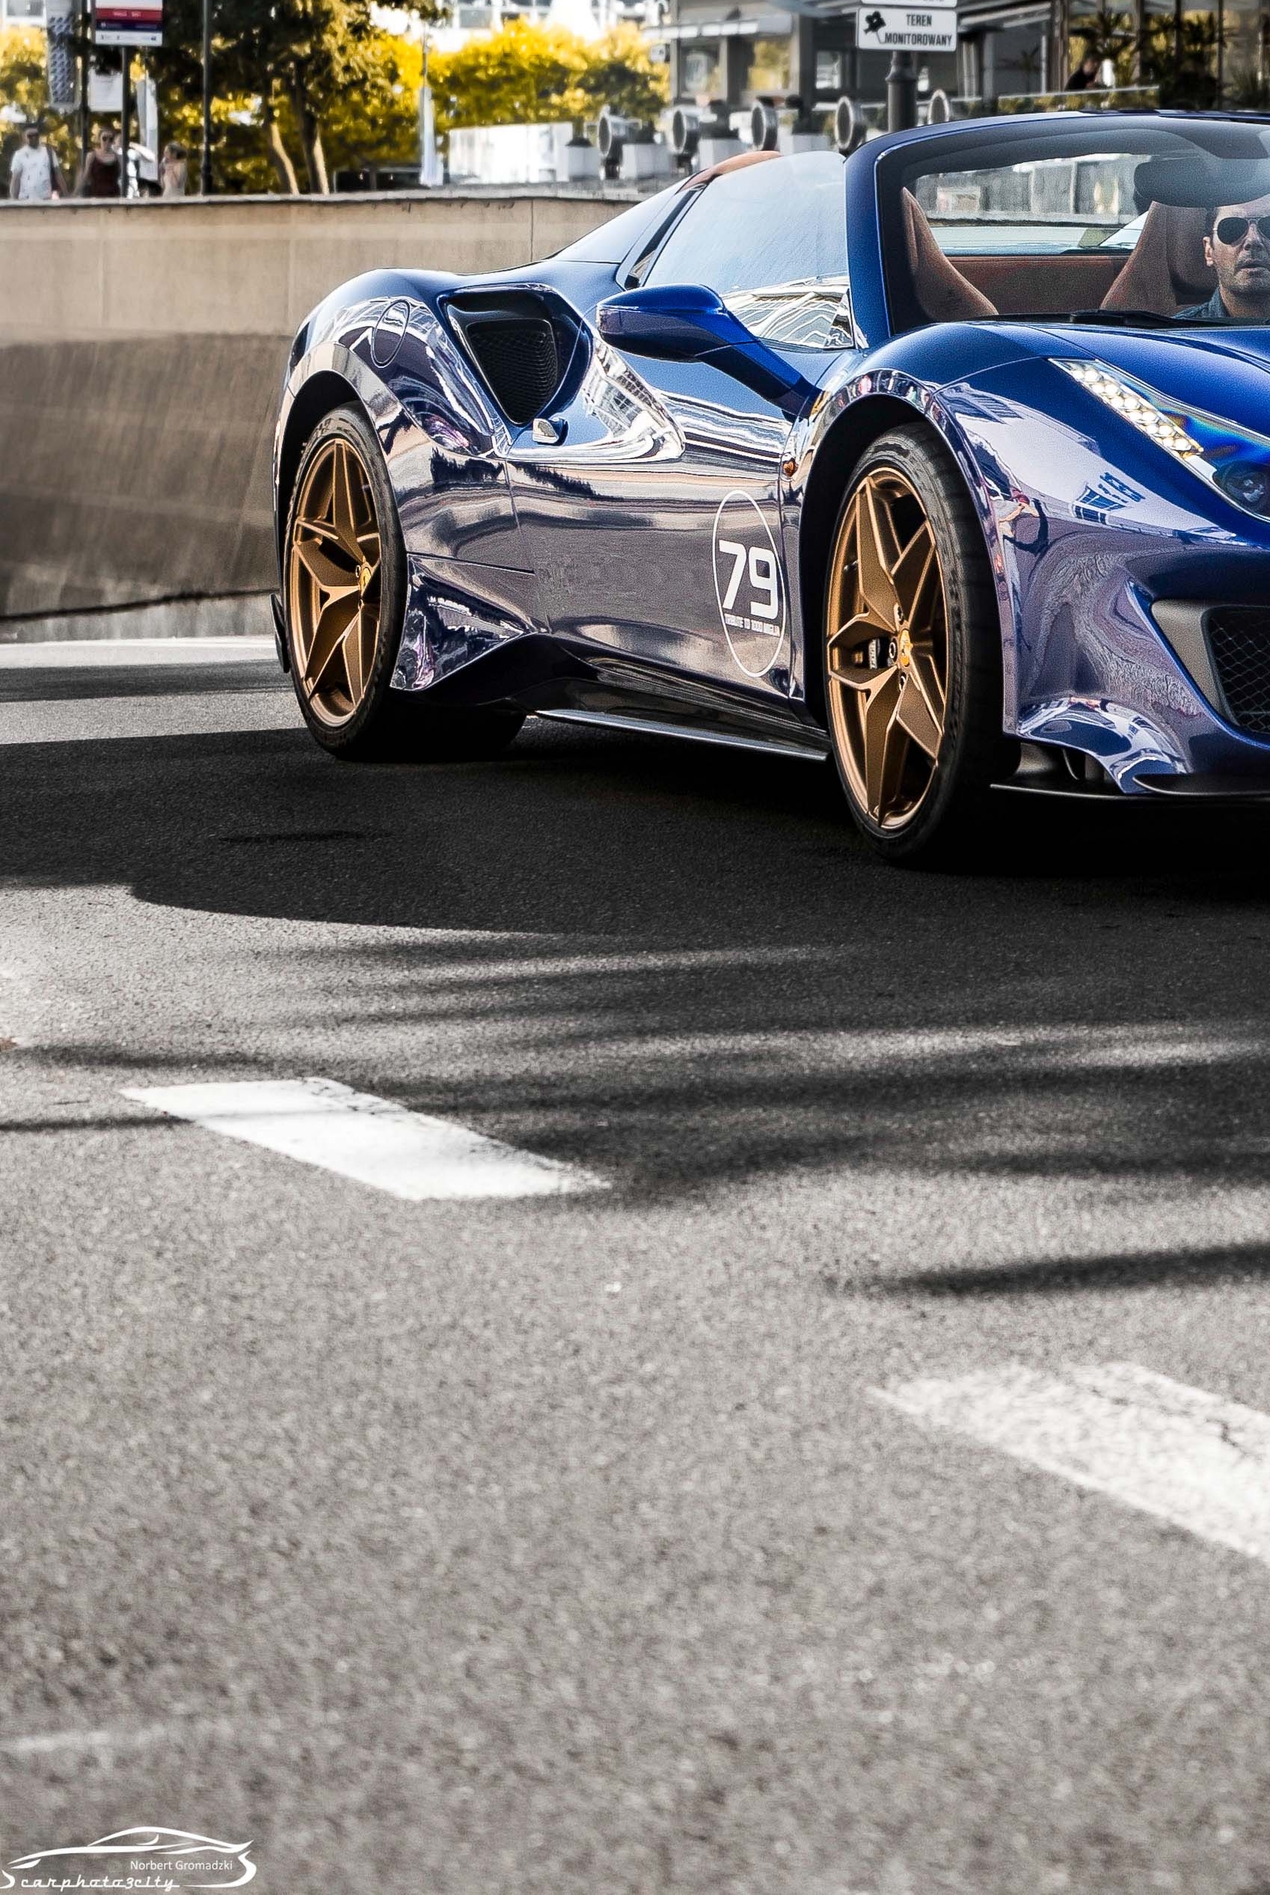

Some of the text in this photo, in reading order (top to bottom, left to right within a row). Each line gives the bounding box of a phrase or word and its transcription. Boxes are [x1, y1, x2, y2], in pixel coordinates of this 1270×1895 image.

[906, 13, 933, 27] TEREN
[884, 31, 953, 47] MONITOROWANY
[718, 538, 779, 621] 79
